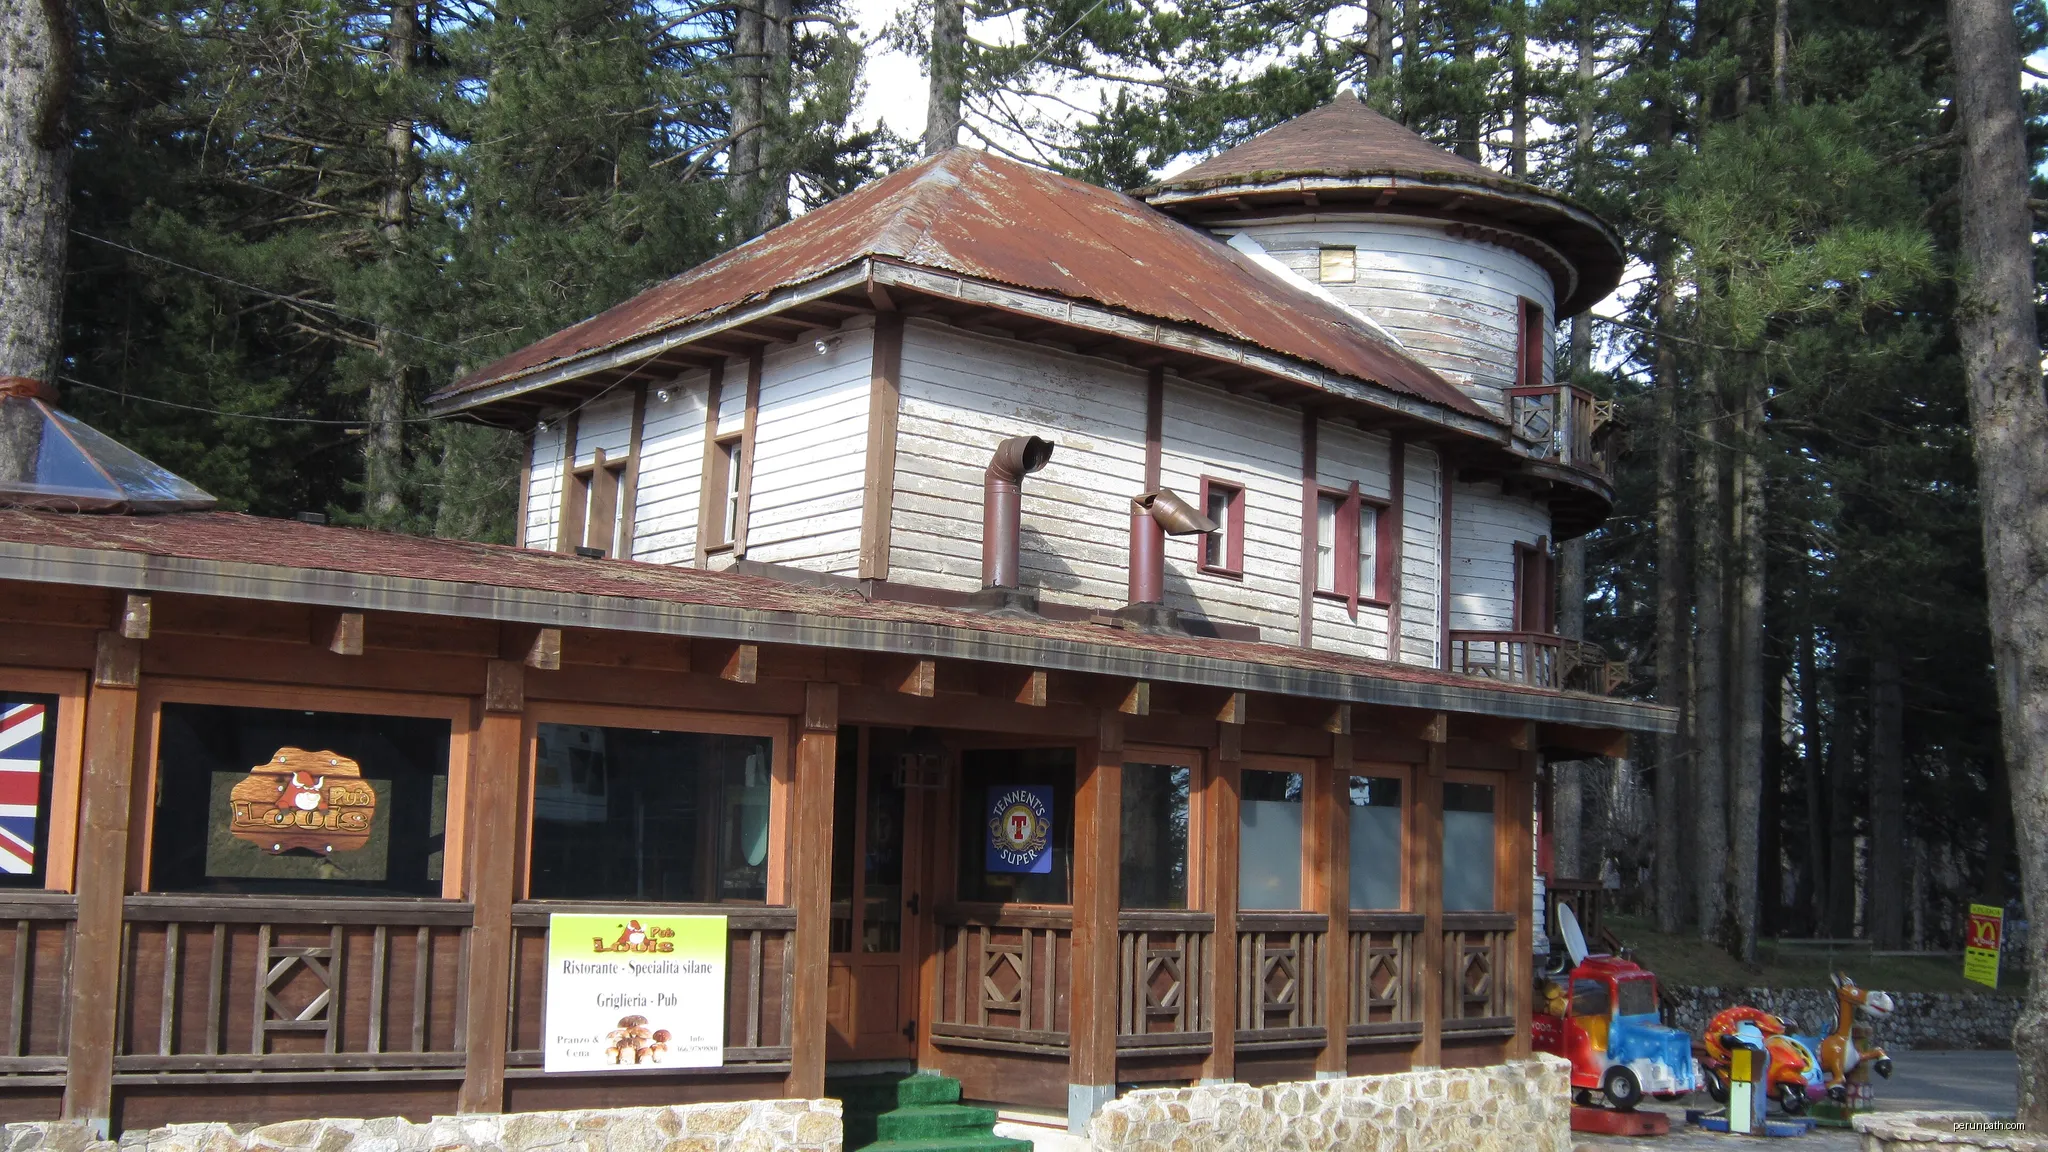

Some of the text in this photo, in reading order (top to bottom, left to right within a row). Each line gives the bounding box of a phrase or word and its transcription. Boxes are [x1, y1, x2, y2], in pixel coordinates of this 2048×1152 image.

[329, 786, 370, 806] Pub
[993, 790, 1045, 816] TENNENT'S
[231, 801, 368, 831] Louis
[1012, 816, 1026, 839] T
[1000, 849, 1038, 866] SUPER
[650, 927, 676, 939] Pub
[592, 937, 675, 953] Louis
[563, 960, 618, 975] Ristorante
[627, 960, 680, 977] Specialità
[682, 961, 713, 975] silane
[596, 993, 647, 1010] Griglieria
[657, 993, 678, 1008] Pub
[557, 1035, 600, 1044] Pranzo &
[566, 1048, 590, 1058] Cena
